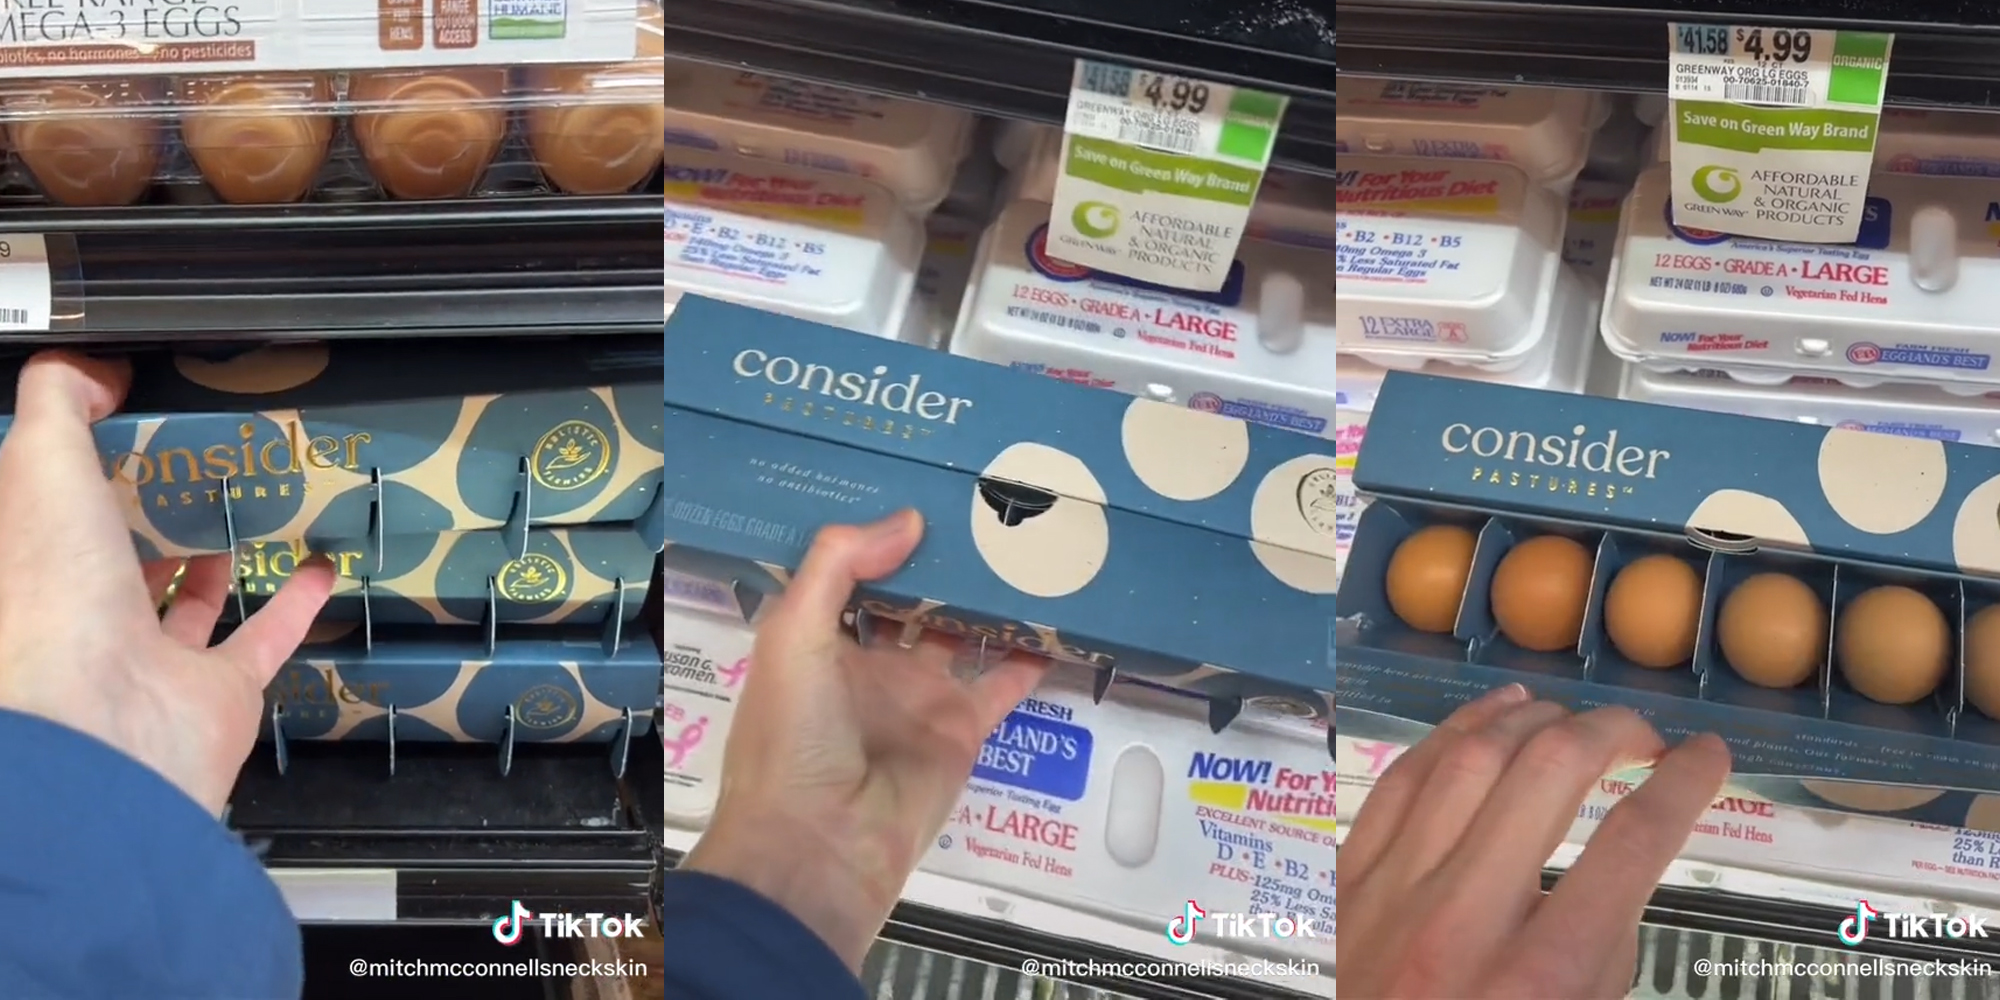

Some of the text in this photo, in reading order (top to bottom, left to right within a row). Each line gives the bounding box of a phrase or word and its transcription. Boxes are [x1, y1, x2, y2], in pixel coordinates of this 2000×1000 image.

[0, 6, 241, 42] MEGA-3 EGGS
[438, 30, 473, 44] ACCESS
[1677, 27, 1812, 64] $41.58 $4.99
[182, 41, 252, 62] pesticides
[1832, 54, 1884, 71] ORGANIC
[1676, 64, 1809, 81] GREENWAY ORG LG EGGS
[1139, 72, 1210, 114] $4.99
[1684, 111, 1869, 141] Save on Green Way Brand
[1074, 145, 1107, 167] Save
[1109, 156, 1127, 171] on
[1130, 160, 1172, 182] Green
[1206, 172, 1250, 194] Brand
[1358, 173, 1397, 188] For
[1401, 169, 1450, 185] Your
[1750, 169, 1859, 188] AFFORDABLE
[1447, 179, 1499, 197] Diet
[1763, 184, 1843, 201] NATURAL
[1753, 195, 1851, 216] & ORGANIC
[1129, 209, 1233, 239] AFFORDABLE
[1756, 209, 1845, 227] PRODUCTS
[1140, 225, 1213, 249] NATURAL
[1354, 230, 1462, 248] B2 B12 B5
[1144, 239, 1220, 264] ORGANIC
[1370, 246, 1428, 259] Omega 3
[1349, 263, 1394, 276] Regular
[1379, 257, 1437, 270] Saturated
[1439, 260, 1460, 271] Fat
[1654, 253, 1889, 286] 12 EGGS GRADE A LARGE
[1785, 285, 1888, 305] Vegetarian Fed Hens
[1012, 284, 1029, 298] 12
[1032, 287, 1070, 308] EGGS
[1080, 297, 1128, 320] GRADE
[1154, 307, 1239, 342] LARGE
[1359, 315, 1379, 336] 12
[1660, 332, 1696, 344] NOW!
[1952, 357, 1986, 368] BEST
[733, 349, 973, 425] consider
[104, 420, 371, 486] onsider
[1441, 422, 1670, 479] consider
[134, 483, 313, 507] ASTURES
[664, 650, 701, 669] usan
[994, 720, 1078, 762] LAND'S
[977, 743, 1036, 777] BEST
[1187, 751, 1273, 785] NOW!
[1274, 767, 1318, 792] For
[966, 781, 1004, 798] uperior
[984, 803, 1080, 852] LARGE
[1195, 804, 1266, 832] EXCELLENT
[1268, 821, 1320, 844] SOURCE
[1723, 821, 1742, 840] Fed
[1744, 825, 1774, 844] Hens
[1199, 819, 1274, 853] Vitamins
[1953, 836, 1985, 854] 25%
[965, 836, 1073, 879] Vegetarian Fed Hens
[1217, 842, 1234, 861] D
[1253, 850, 1266, 871] E
[1285, 857, 1310, 882] B2
[1952, 851, 1985, 868] than
[1249, 887, 1282, 908] 25%
[1286, 896, 1317, 918] Less
